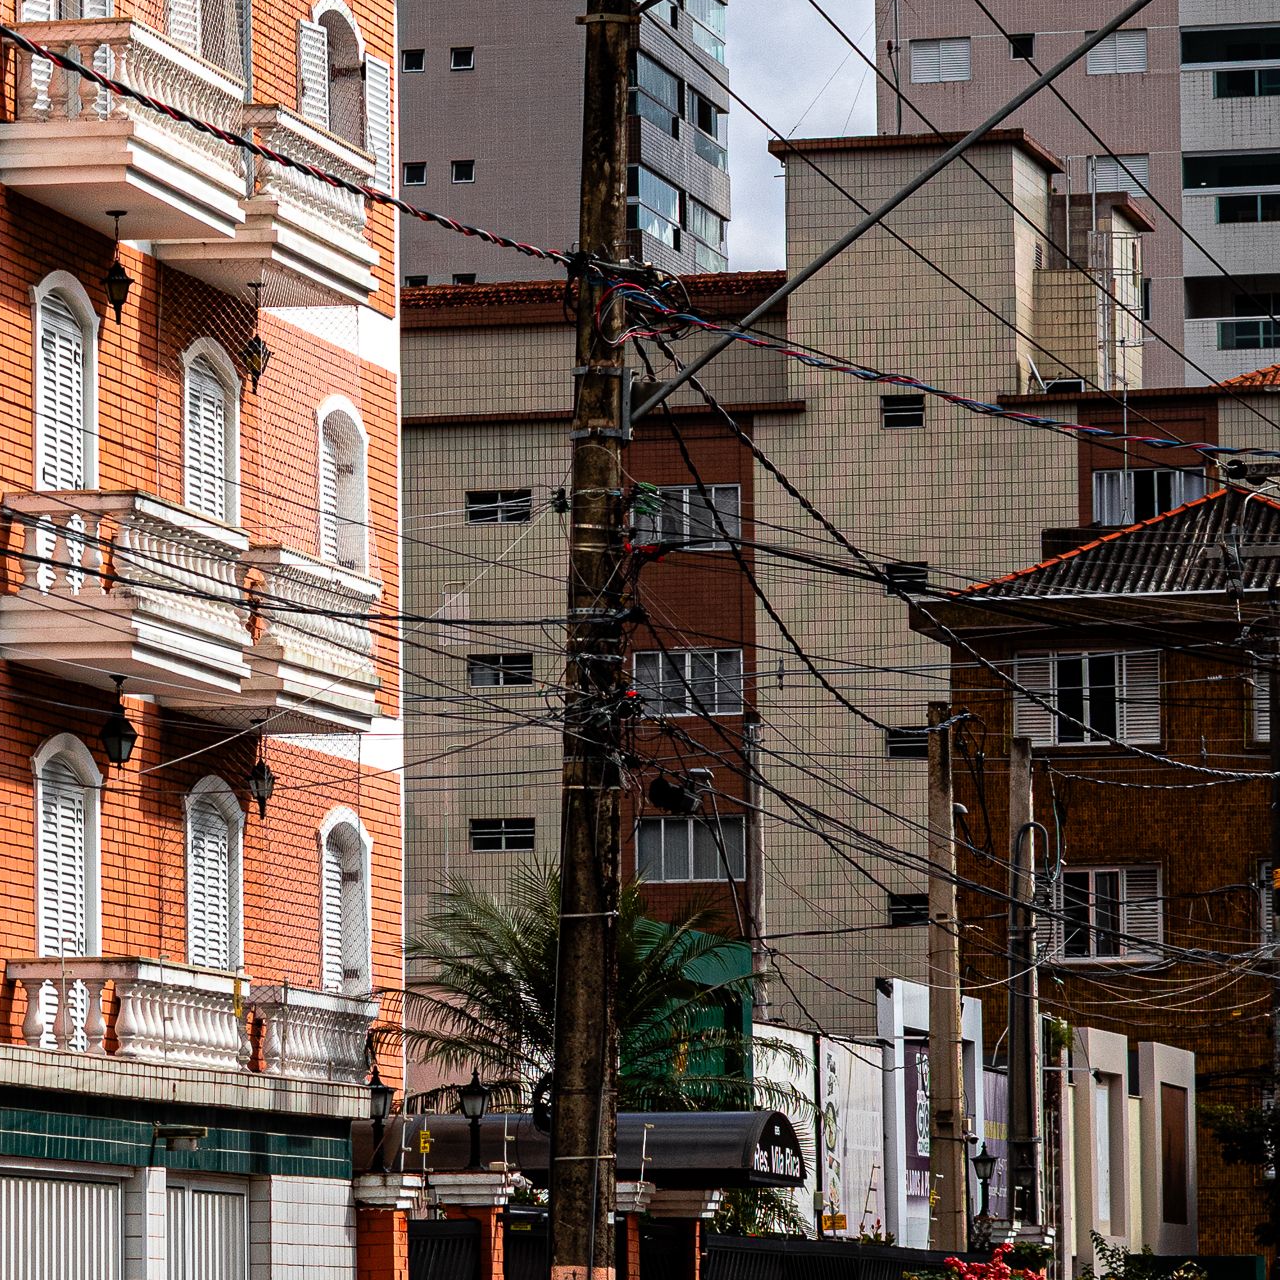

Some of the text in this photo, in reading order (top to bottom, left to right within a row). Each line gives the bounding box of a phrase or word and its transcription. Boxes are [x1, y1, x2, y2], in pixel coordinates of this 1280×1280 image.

[754, 1142, 800, 1178] Res. Vila Rica
